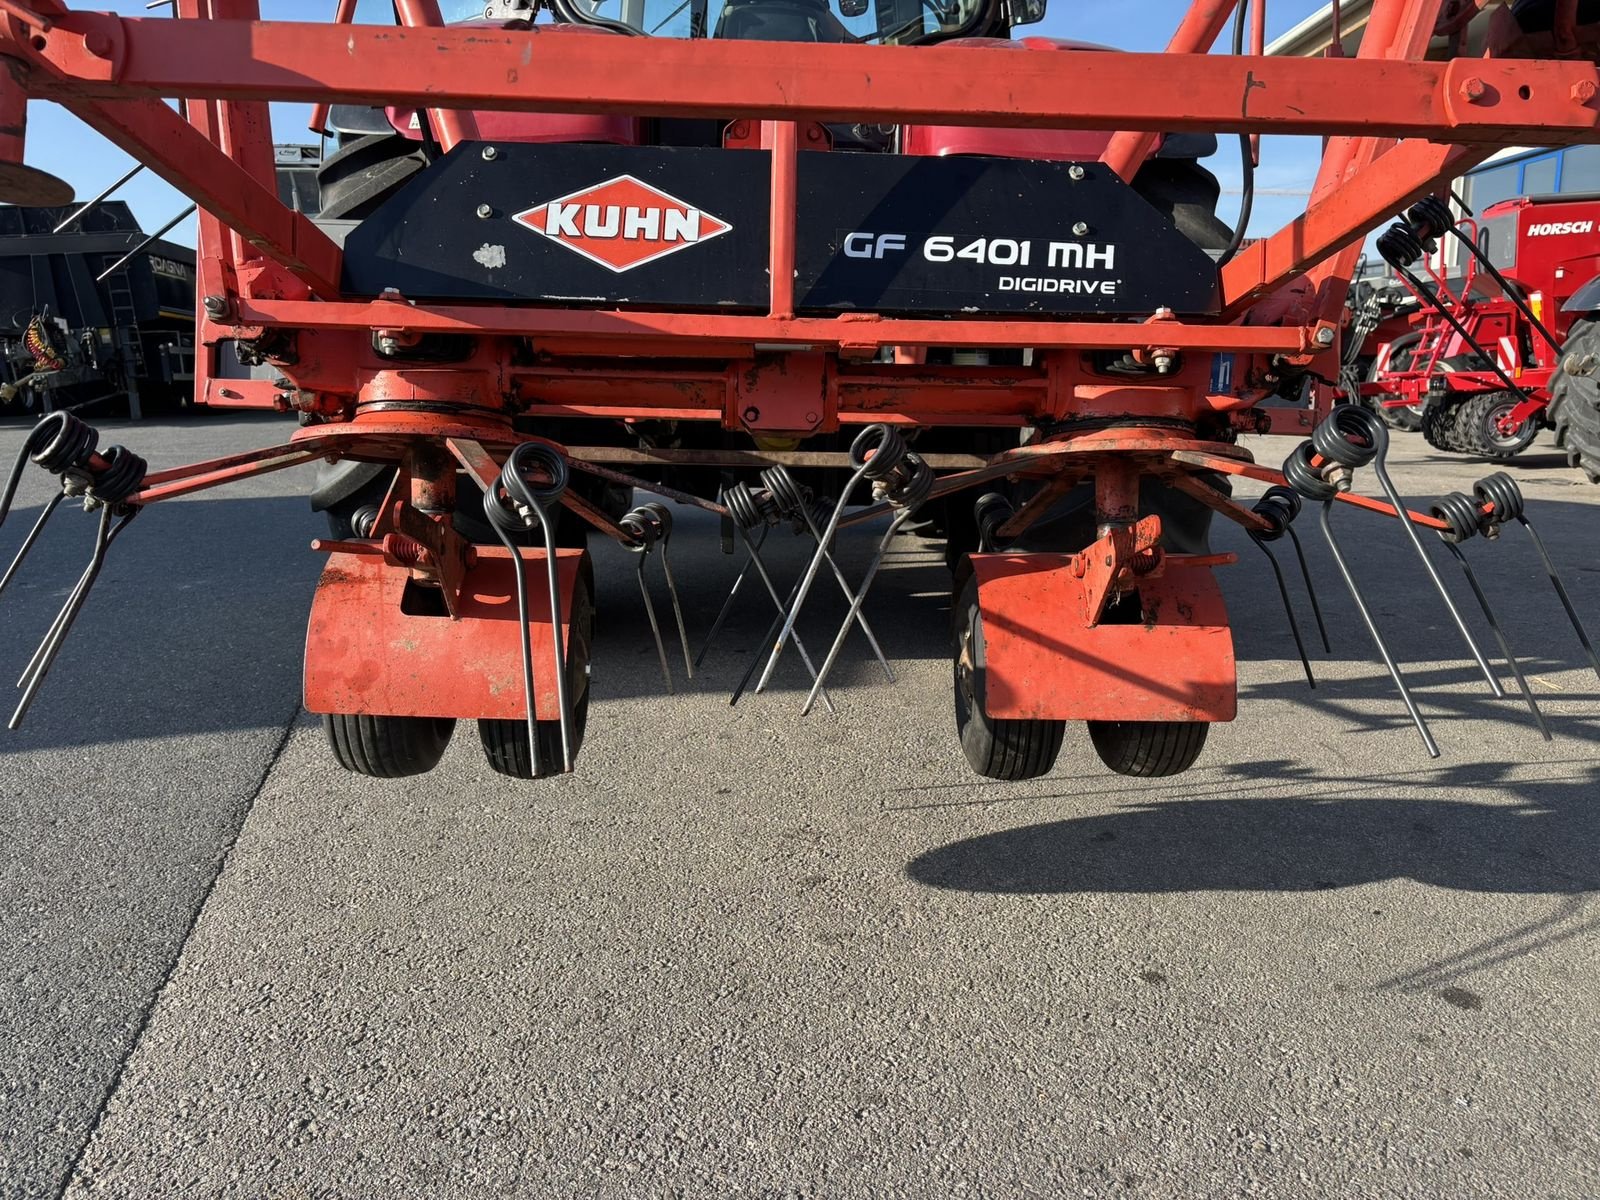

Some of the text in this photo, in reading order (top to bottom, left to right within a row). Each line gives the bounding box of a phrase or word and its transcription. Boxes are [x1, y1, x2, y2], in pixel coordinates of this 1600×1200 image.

[545, 203, 700, 242] KUHN
[1527, 221, 1593, 236] HORSCH
[843, 232, 1115, 269] GF 6401 MH
